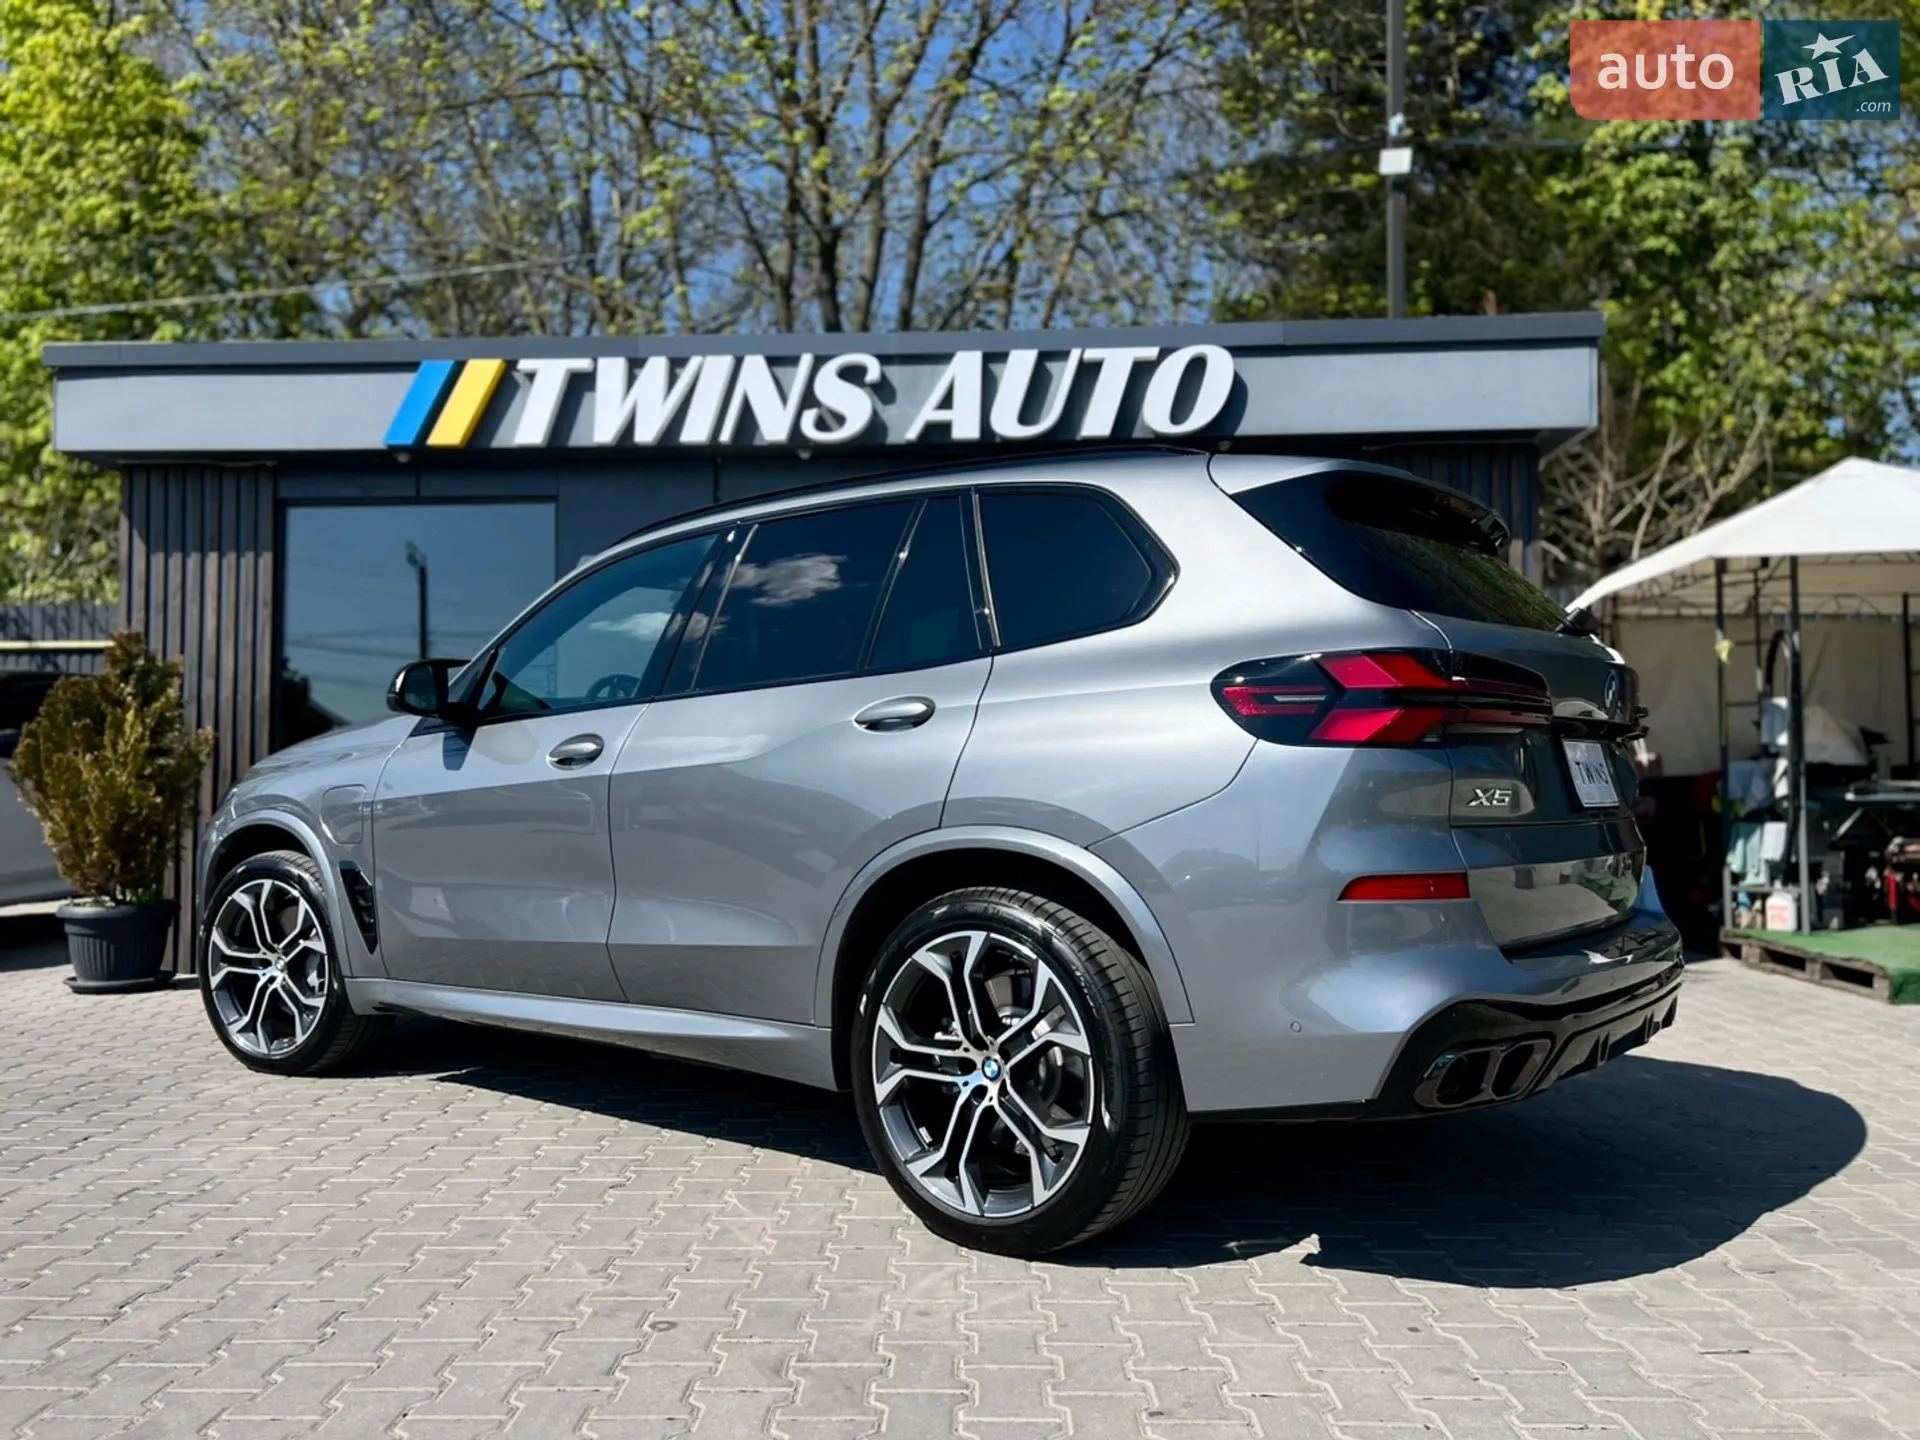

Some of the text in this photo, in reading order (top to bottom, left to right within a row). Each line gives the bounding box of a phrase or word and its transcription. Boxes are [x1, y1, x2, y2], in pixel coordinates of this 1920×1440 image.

[513, 343, 1236, 446] TWINS AUTO
[1468, 788, 1511, 807] X5
